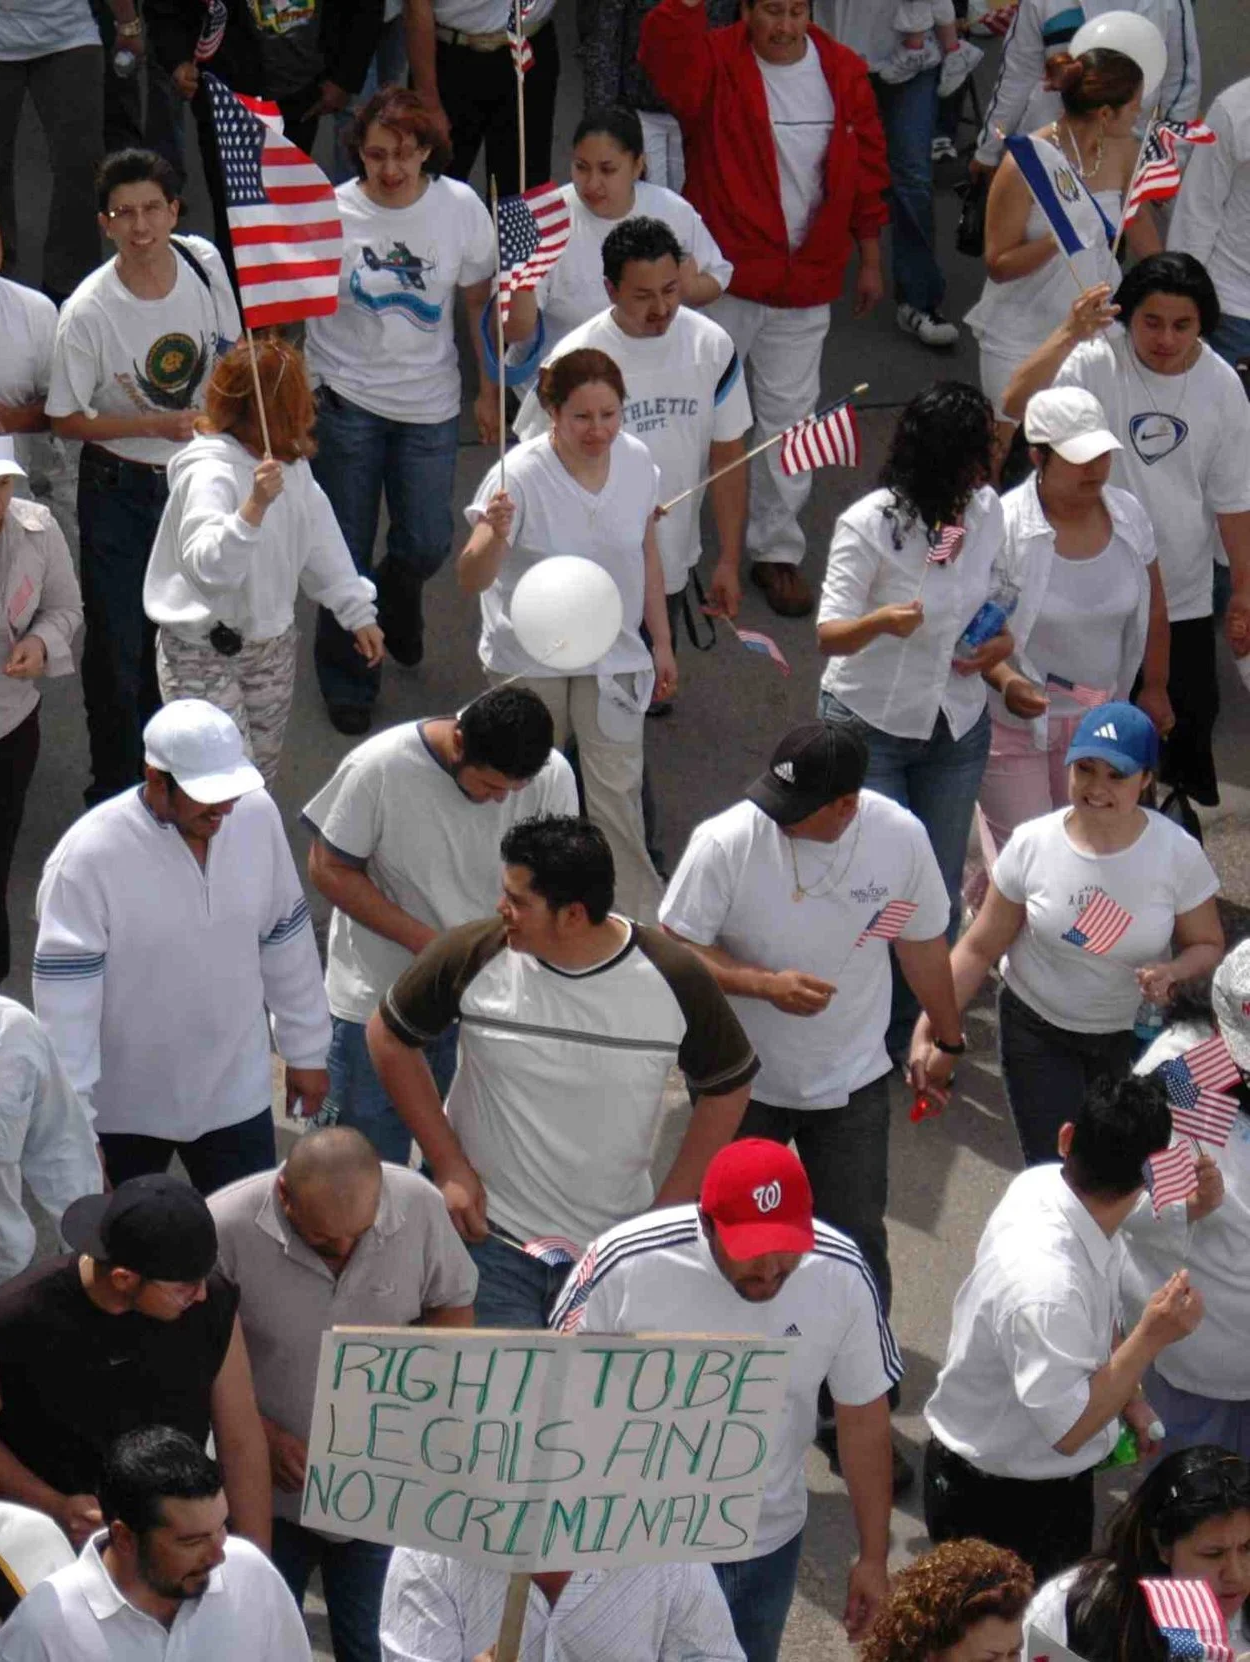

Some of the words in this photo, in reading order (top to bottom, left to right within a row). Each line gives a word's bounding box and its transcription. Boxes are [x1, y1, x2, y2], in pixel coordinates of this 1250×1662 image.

[333, 1342, 556, 1416] RIGHT
[327, 1402, 585, 1485] LEGALS
[603, 1419, 767, 1483] AND
[303, 1463, 427, 1531] NOT
[424, 1490, 754, 1562] CRIMINALS
